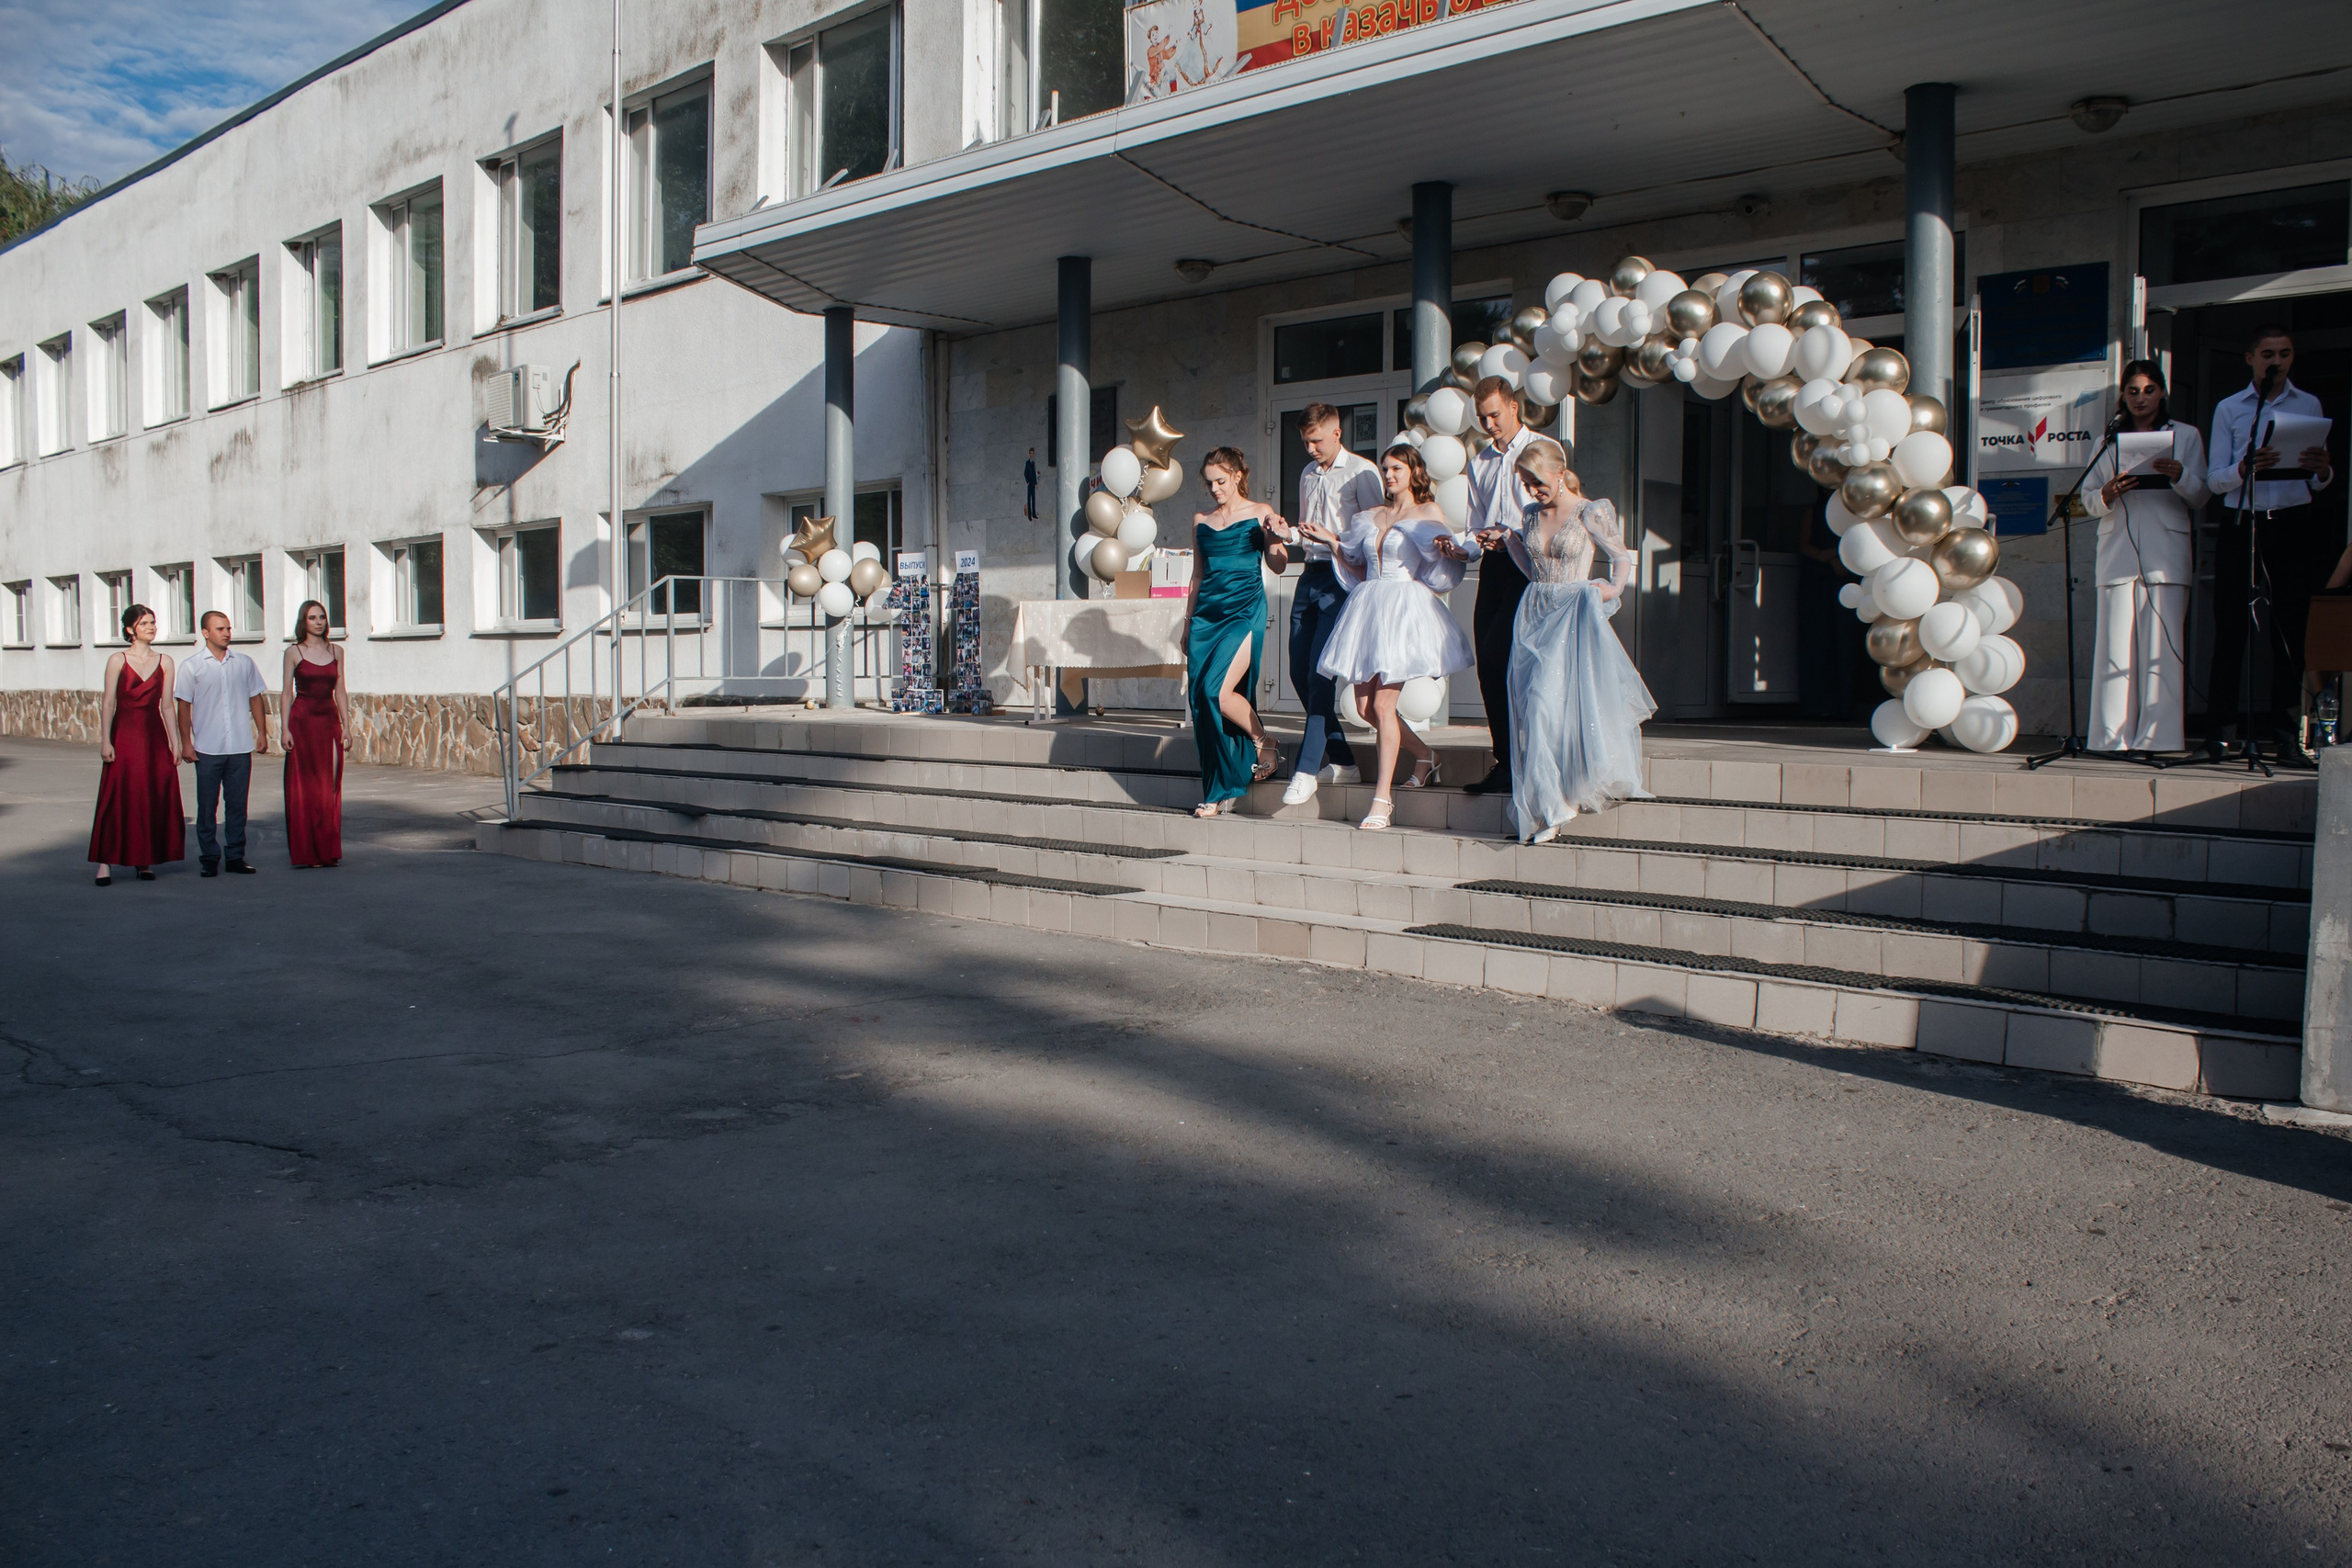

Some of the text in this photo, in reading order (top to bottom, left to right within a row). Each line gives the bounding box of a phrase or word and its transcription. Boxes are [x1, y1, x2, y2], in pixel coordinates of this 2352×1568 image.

[1293, 24, 1312, 57] в
[1981, 431, 2091, 446] ТОЧКА РОСТА
[960, 557, 976, 568] 2024
